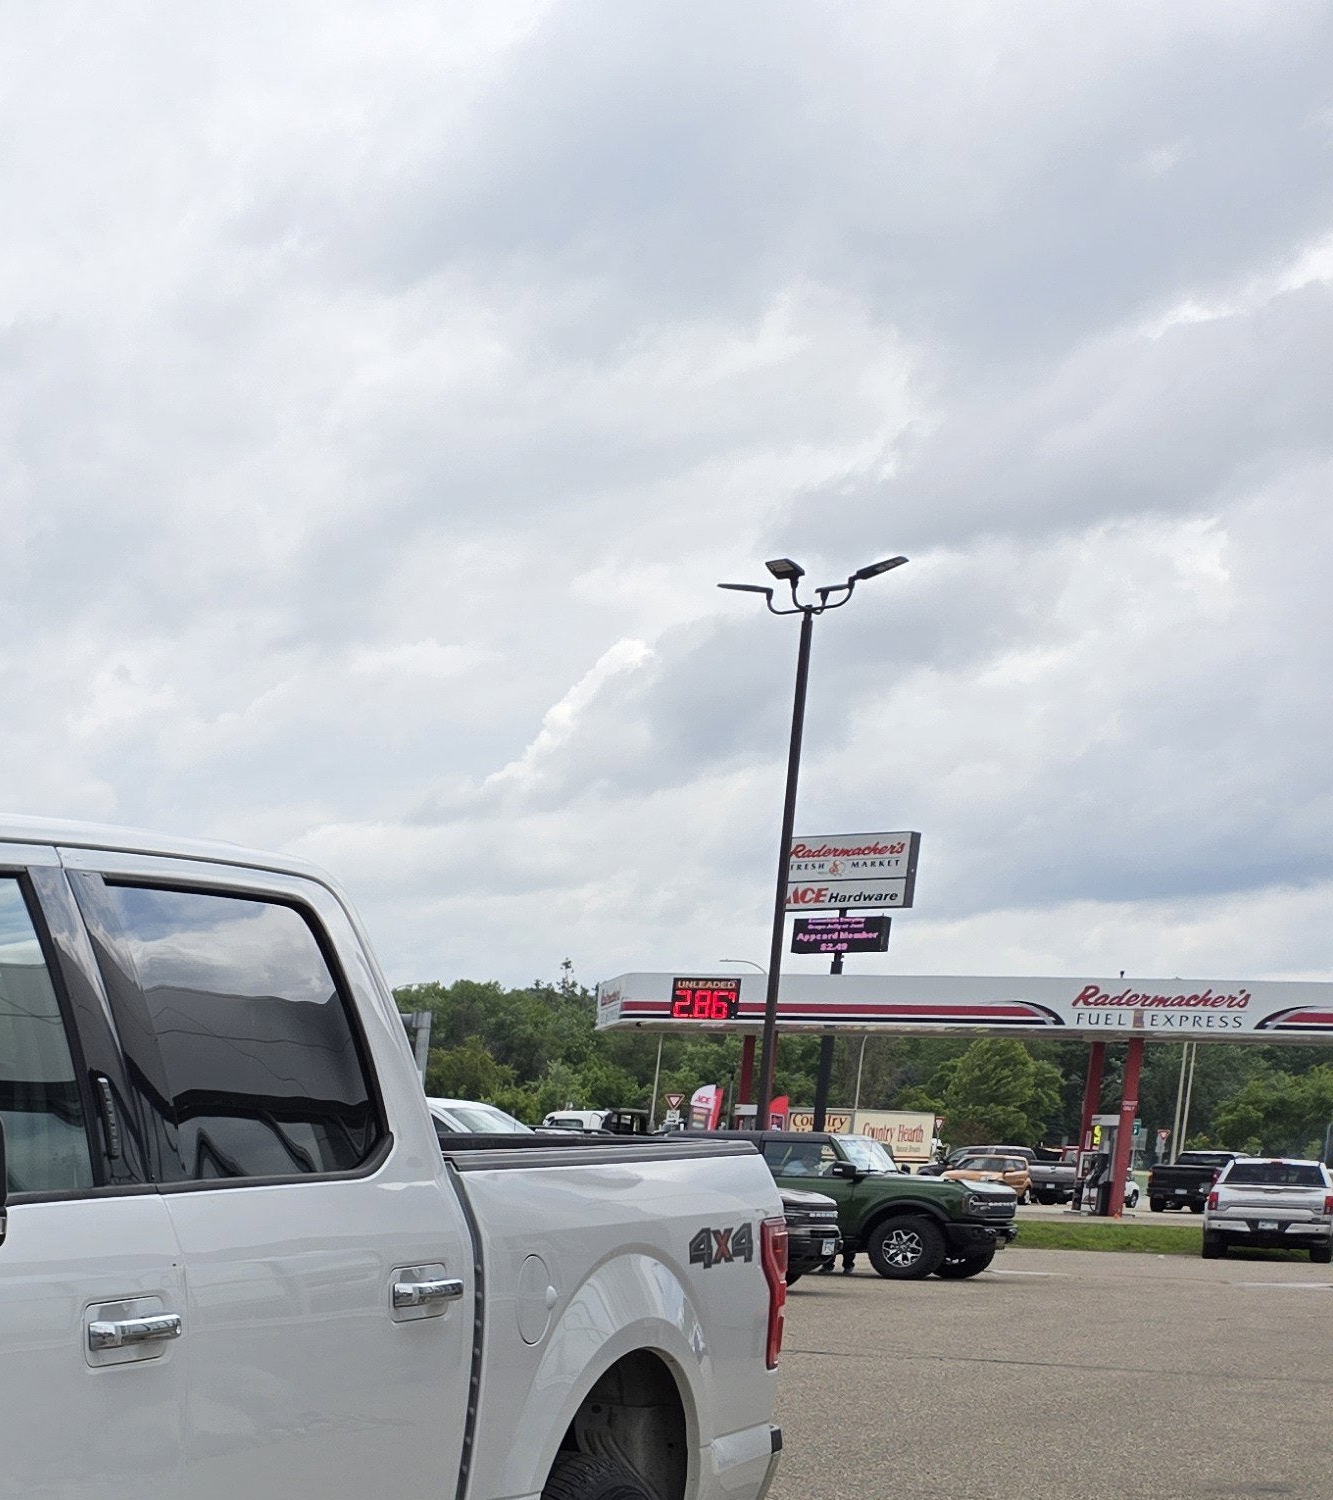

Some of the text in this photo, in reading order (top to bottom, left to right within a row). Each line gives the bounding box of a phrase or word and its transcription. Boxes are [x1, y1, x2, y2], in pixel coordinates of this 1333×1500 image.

[790, 842, 906, 858] Radermacher's
[790, 859, 900, 870] FRESH MARKET
[784, 886, 898, 904] ACE Hardware
[678, 981, 736, 989] UNLEADED
[1072, 985, 1251, 1008] Radermacher's
[1076, 1012, 1242, 1028] FUEL EXPRESS
